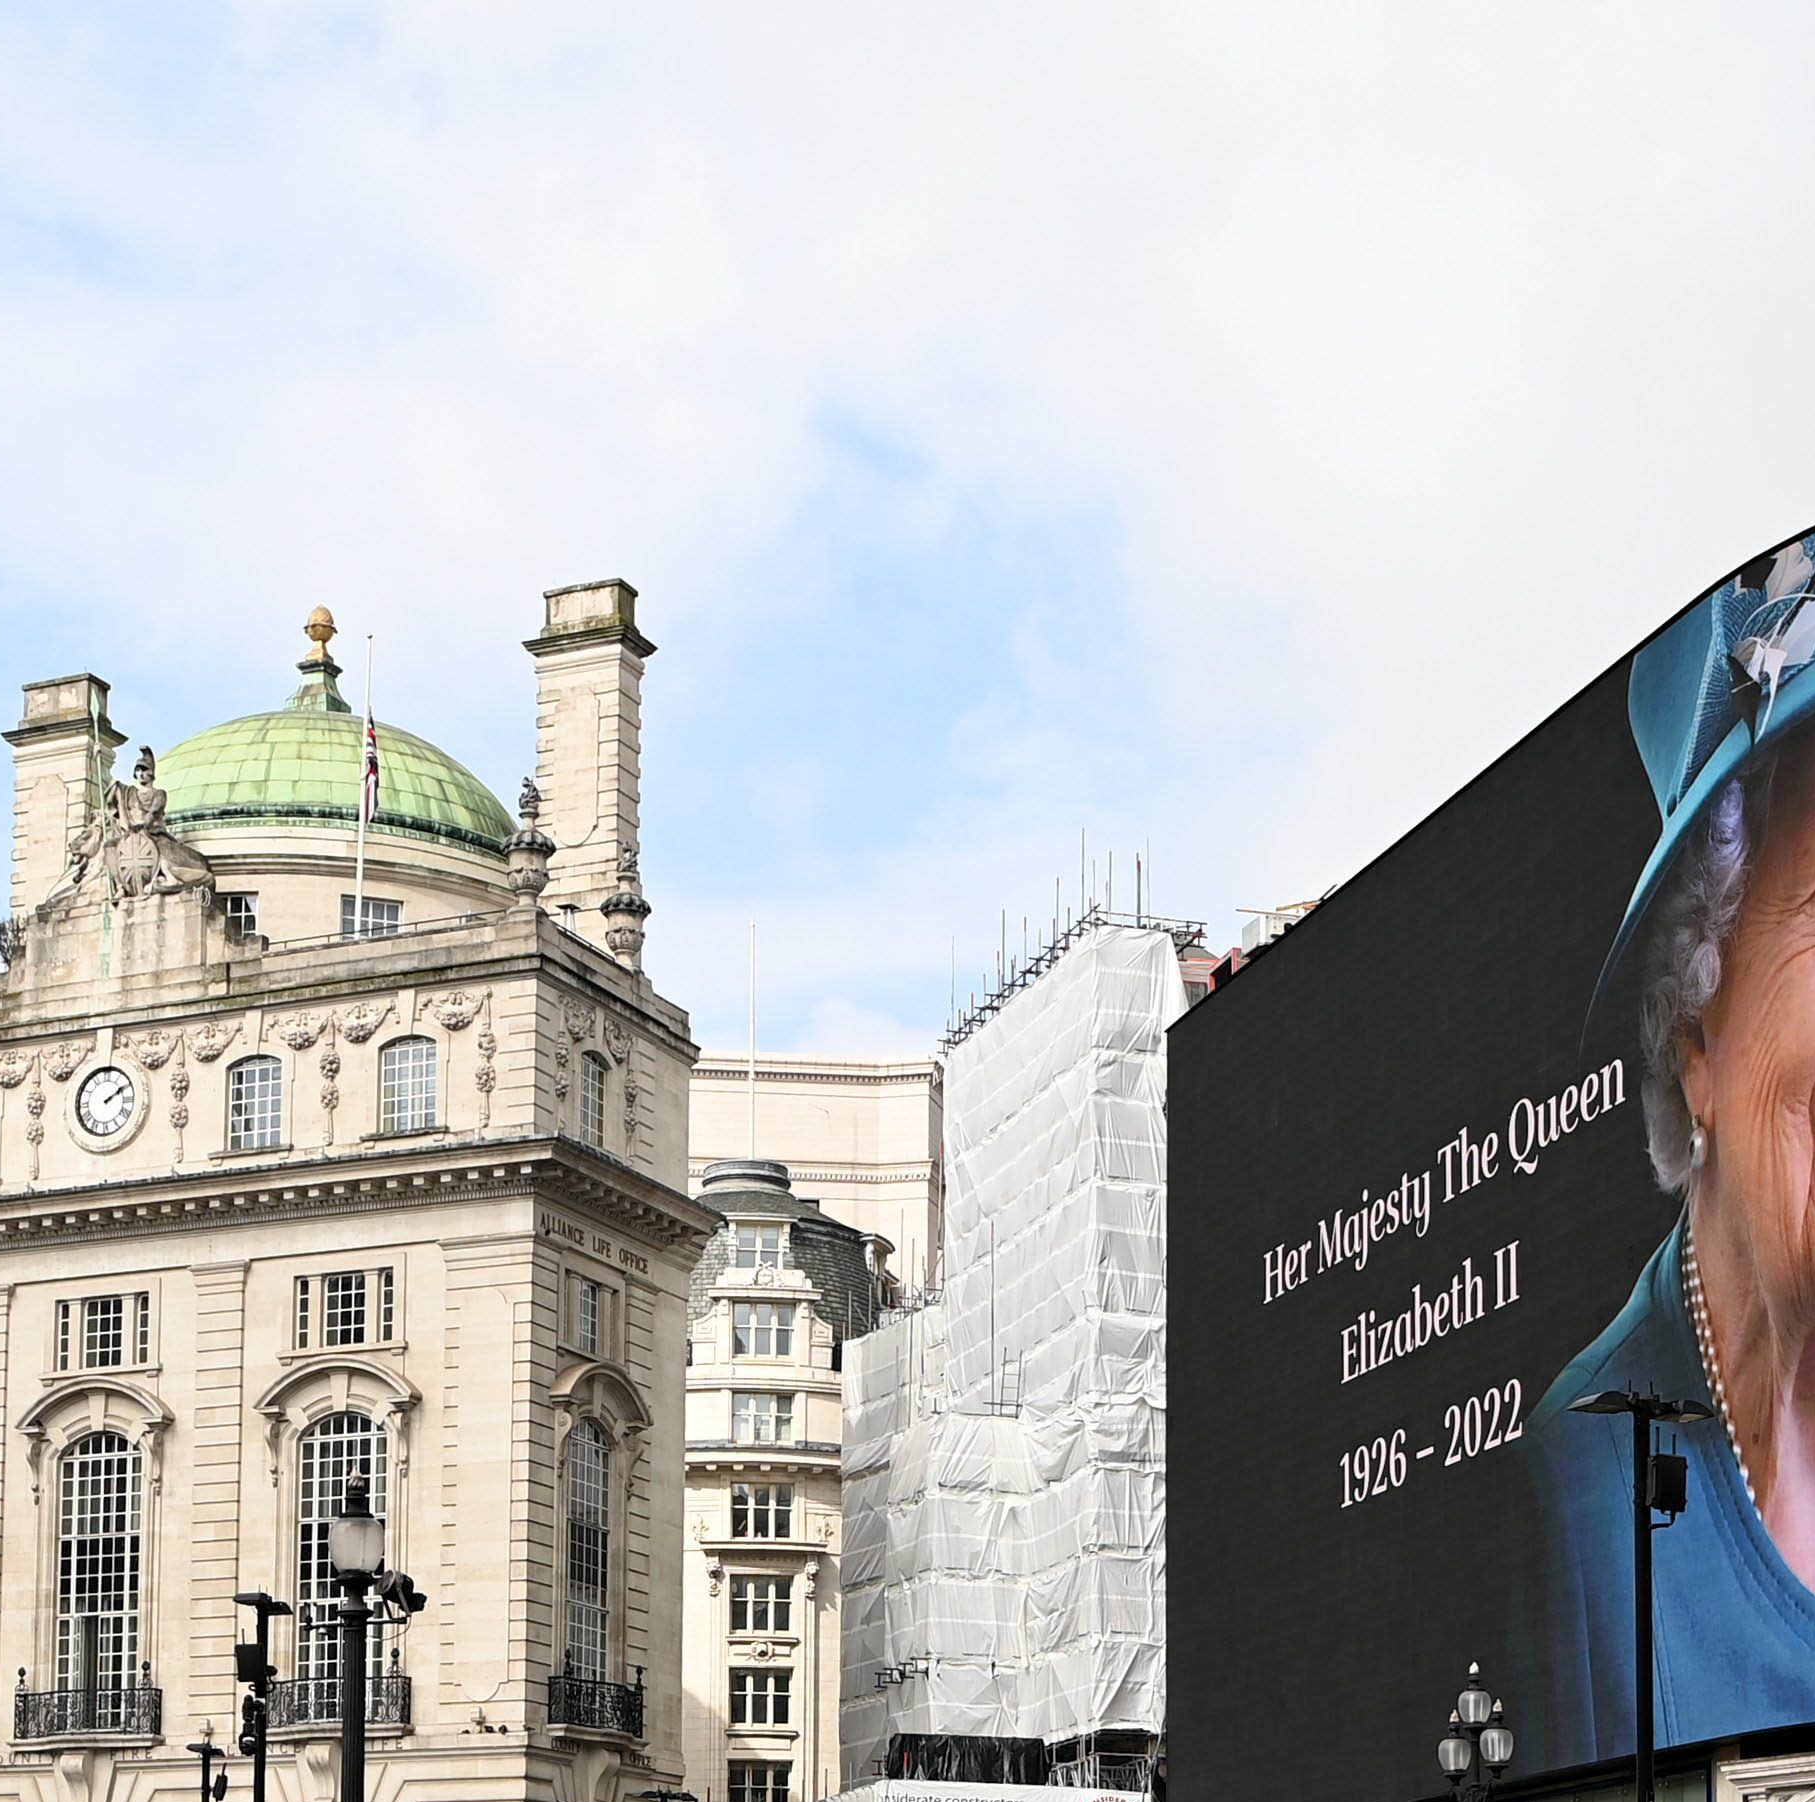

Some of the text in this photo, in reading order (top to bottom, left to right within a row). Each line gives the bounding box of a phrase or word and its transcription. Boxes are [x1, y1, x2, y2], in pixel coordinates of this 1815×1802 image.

[540, 1213, 649, 1274] ALLIANCE LIFE OFFICE
[1263, 1058, 1626, 1304] Her Majesty The Queen
[1340, 1240, 1521, 1384] Elizabeth II
[1340, 1429, 1407, 1508] 1926
[1444, 1379, 1523, 1467] 2022
[109, 1748, 153, 1761] FIRE
